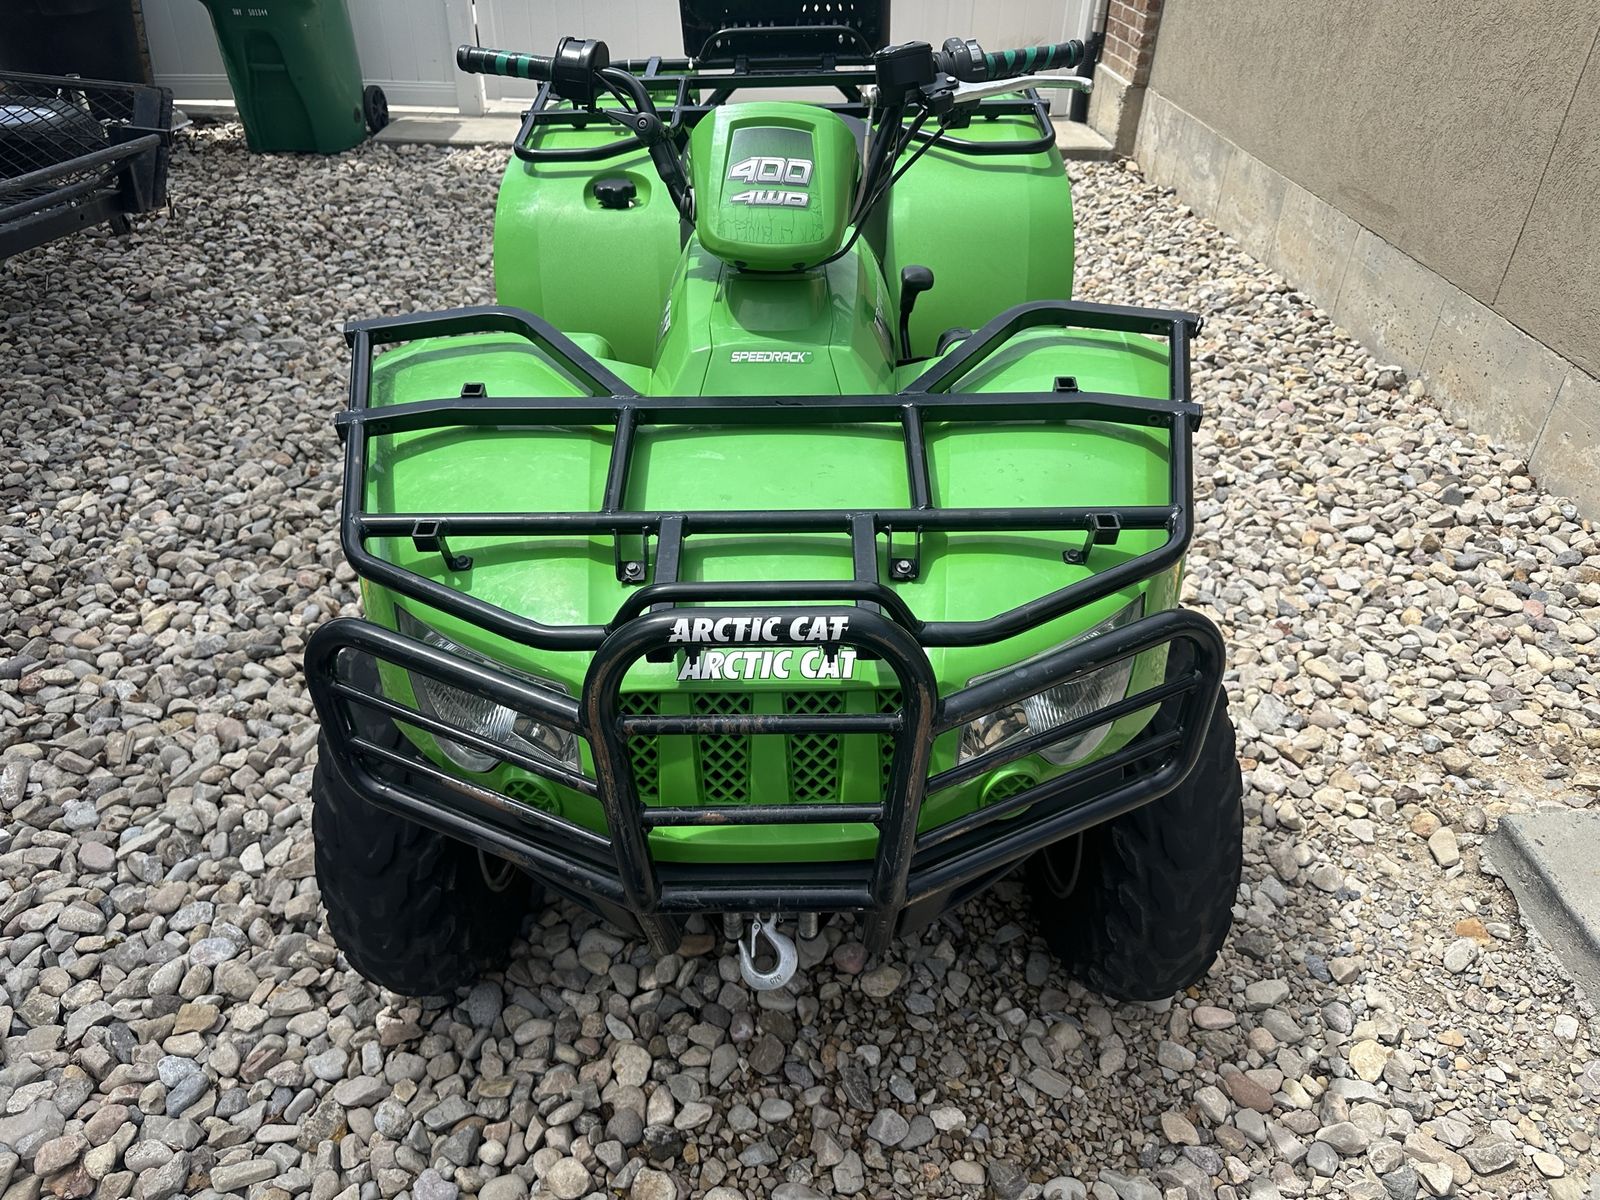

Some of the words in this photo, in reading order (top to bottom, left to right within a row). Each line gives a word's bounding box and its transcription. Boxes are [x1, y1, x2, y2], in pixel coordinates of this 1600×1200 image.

[728, 156, 814, 187] 400
[730, 189, 809, 208] 4WD
[730, 351, 806, 364] SPEEDRACK
[668, 617, 782, 643] ARCTIC
[789, 616, 849, 641] CAT
[677, 650, 793, 680] ARCTIC
[800, 650, 857, 680] CAT
